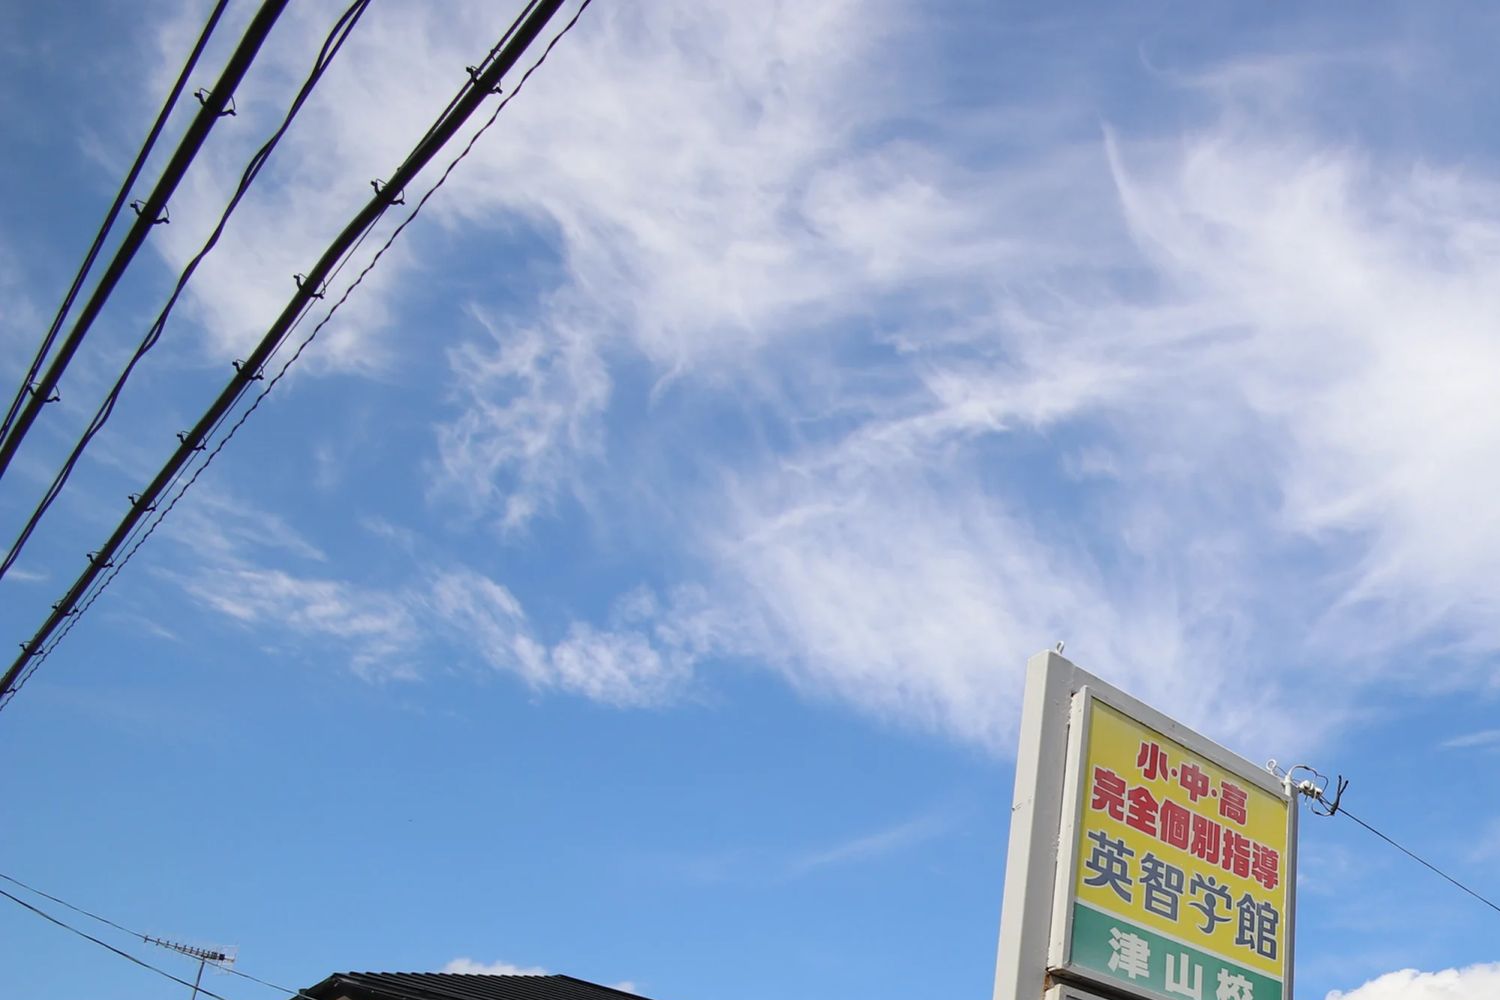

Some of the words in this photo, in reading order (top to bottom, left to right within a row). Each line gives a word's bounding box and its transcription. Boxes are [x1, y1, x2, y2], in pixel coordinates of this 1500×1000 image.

[1090, 765, 1280, 891] 完全個別指導
[1083, 830, 1280, 961] 英智学館
